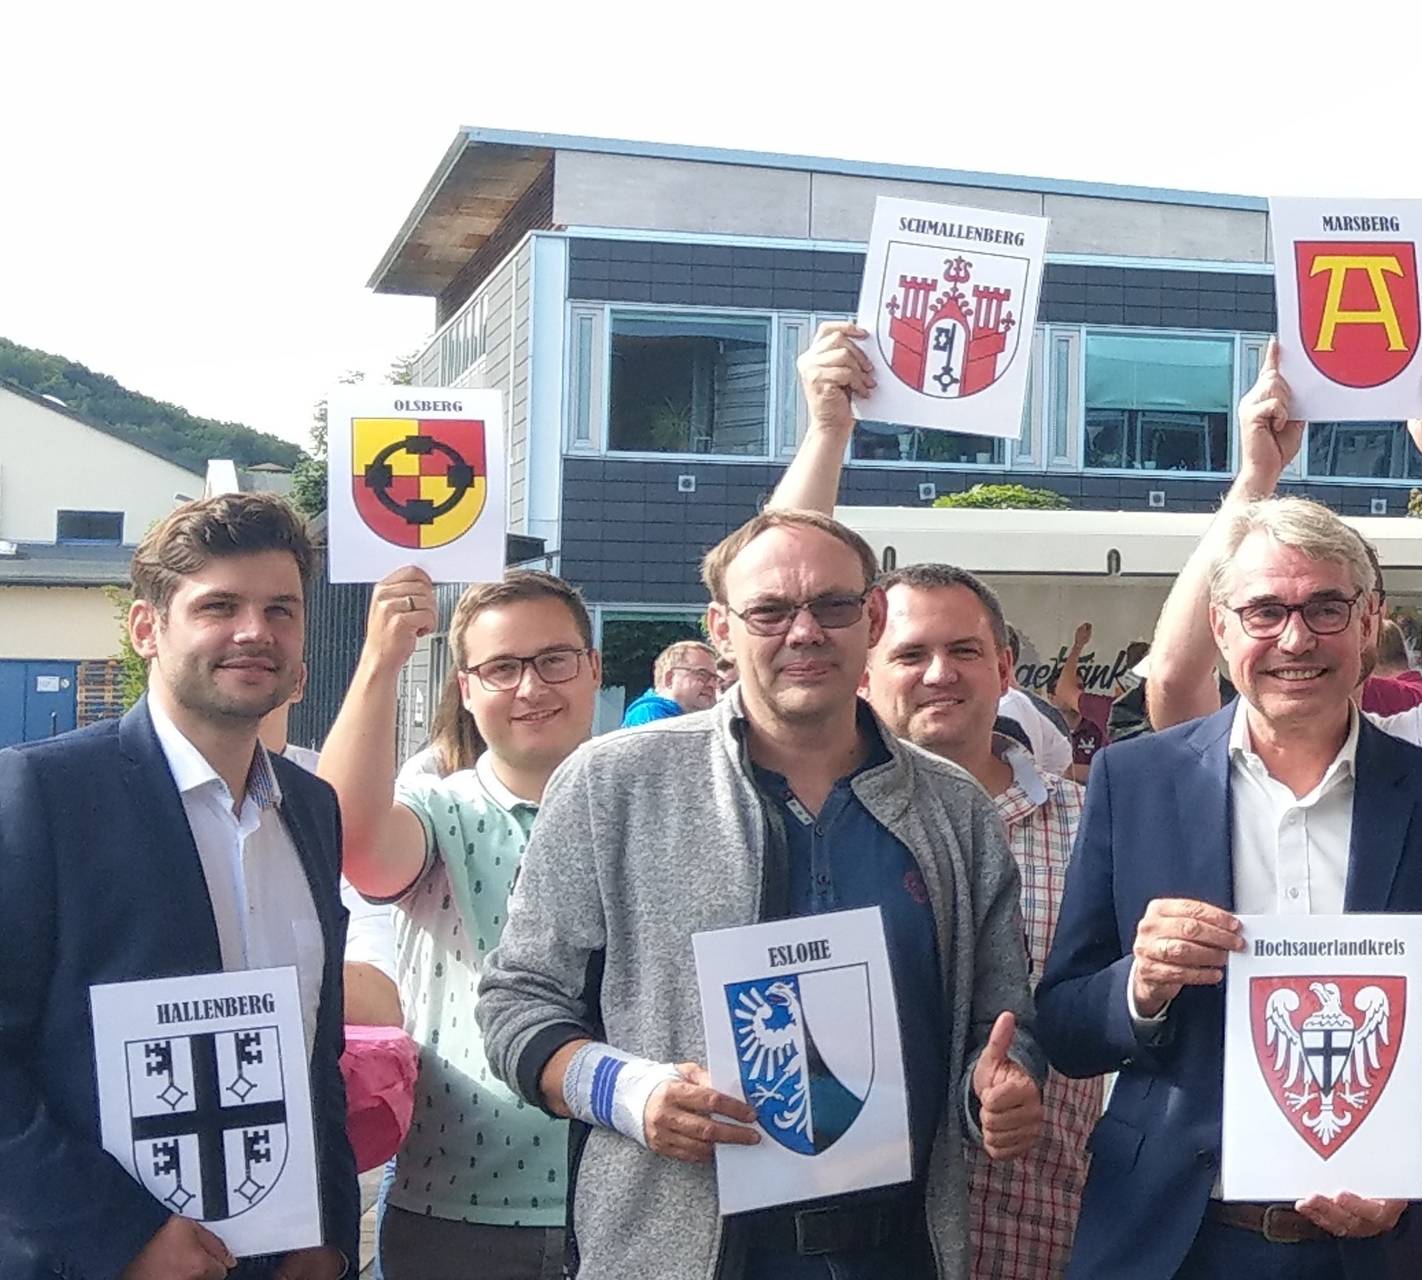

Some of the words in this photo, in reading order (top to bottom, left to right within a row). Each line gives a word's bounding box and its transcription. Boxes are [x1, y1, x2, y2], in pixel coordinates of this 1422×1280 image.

[898, 216, 1025, 247] SCHMALLENBERG
[1322, 215, 1401, 233] MARSBERG
[393, 398, 463, 413] OLSBERG
[769, 939, 832, 968] ESLOHE
[1253, 938, 1406, 958] Hochsauerlandkreis
[156, 992, 275, 1025] HALLENBERG
